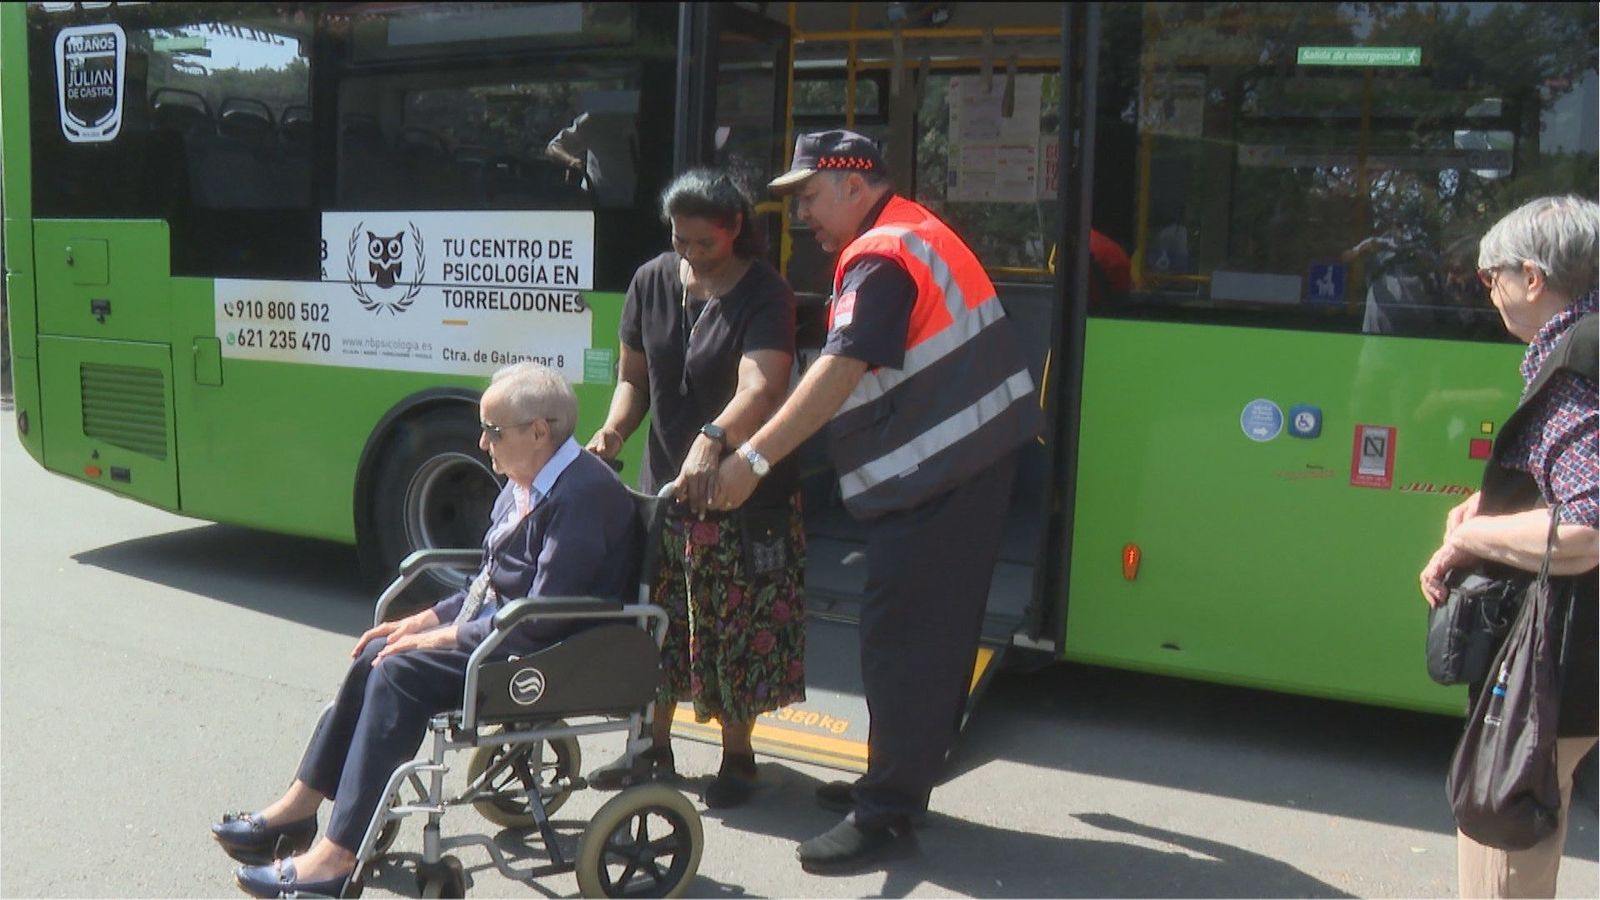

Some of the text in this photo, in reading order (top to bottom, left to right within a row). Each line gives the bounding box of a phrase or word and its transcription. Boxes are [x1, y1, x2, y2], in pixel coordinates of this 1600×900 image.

[1333, 50, 1345, 61] de
[68, 70, 113, 88] JULIAN
[68, 86, 114, 99] DE CASTRO
[442, 239, 573, 260] TU CENTRO DE
[443, 259, 579, 285] PSICOLOGÍA EN
[236, 300, 330, 323] 910 800 502
[442, 290, 586, 314] TORRELODONES
[238, 328, 331, 351] 621 235 470
[442, 348, 470, 362] Ctra.
[474, 350, 488, 363] de
[557, 355, 565, 368] 8
